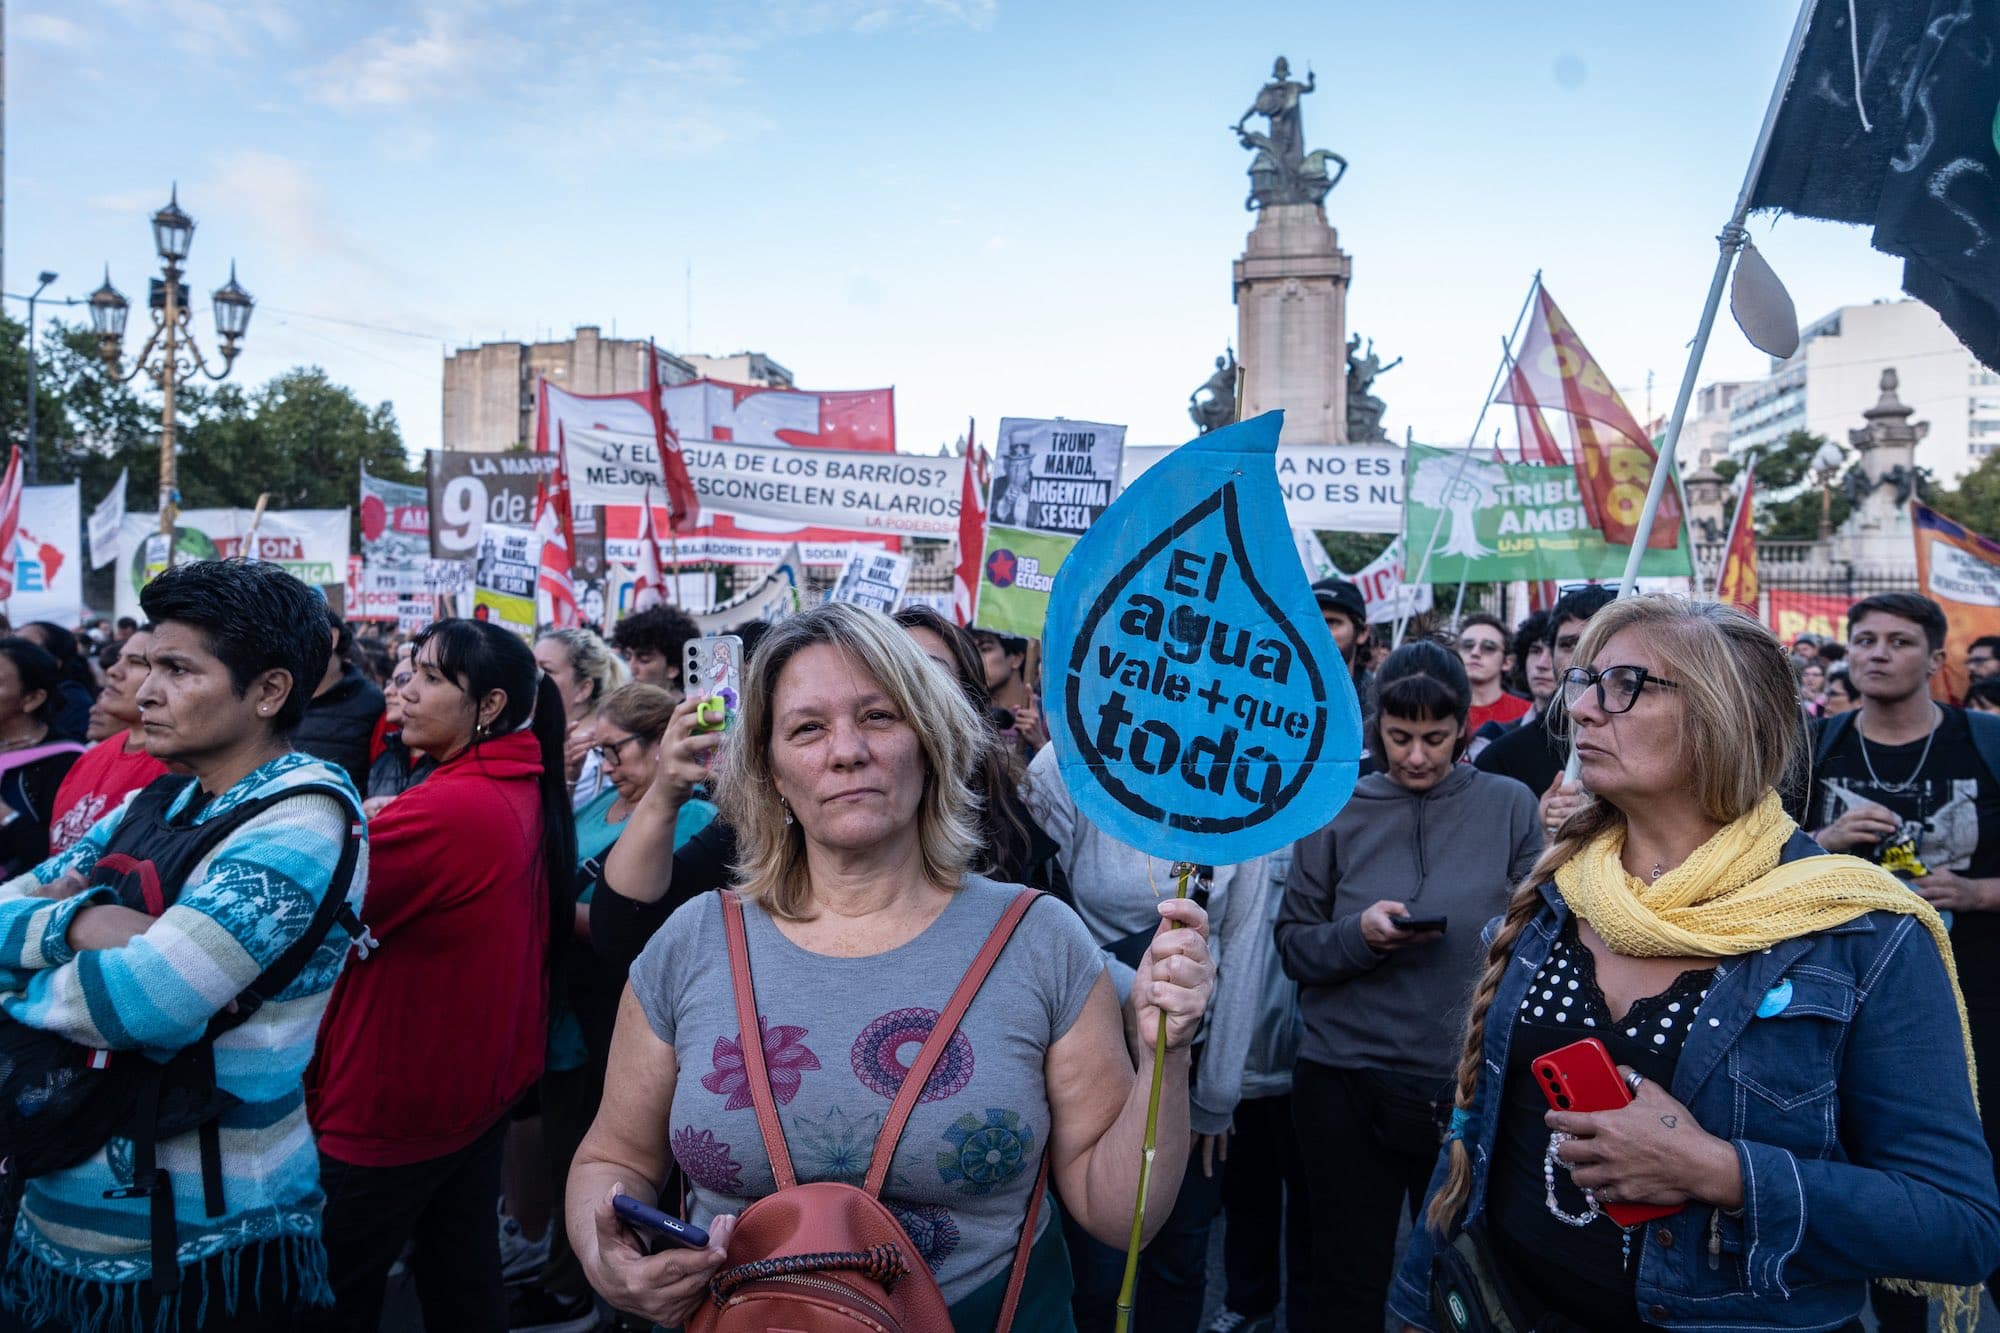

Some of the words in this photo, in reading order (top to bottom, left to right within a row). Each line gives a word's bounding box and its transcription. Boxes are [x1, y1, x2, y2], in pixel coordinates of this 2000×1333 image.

[1052, 432, 1095, 453] TRUMP
[470, 458, 499, 475] LA
[632, 444, 657, 463] EL
[683, 449, 727, 468] GUA
[735, 453, 765, 472] DE
[772, 457, 818, 477] LOS
[825, 461, 947, 488] BARRÍOS?
[1044, 454, 1097, 479] MANDA,
[1306, 457, 1346, 475] NO
[1356, 458, 1391, 476] ES
[841, 489, 961, 517] SALARIOS
[1029, 479, 1107, 506] ARGENTINA
[1325, 484, 1360, 503] ES
[439, 475, 488, 551] 9
[490, 488, 526, 522] de
[865, 516, 882, 528] LA
[1041, 504, 1059, 526] SE
[1059, 507, 1091, 529] SECA
[757, 547, 781, 557] POR
[1498, 538, 1535, 550] UJS
[1017, 557, 1039, 574] RED
[1163, 548, 1228, 604] El
[1119, 593, 1292, 685] agua
[1098, 644, 1191, 703] vale
[1233, 692, 1310, 739] que
[1096, 690, 1282, 804] todo
